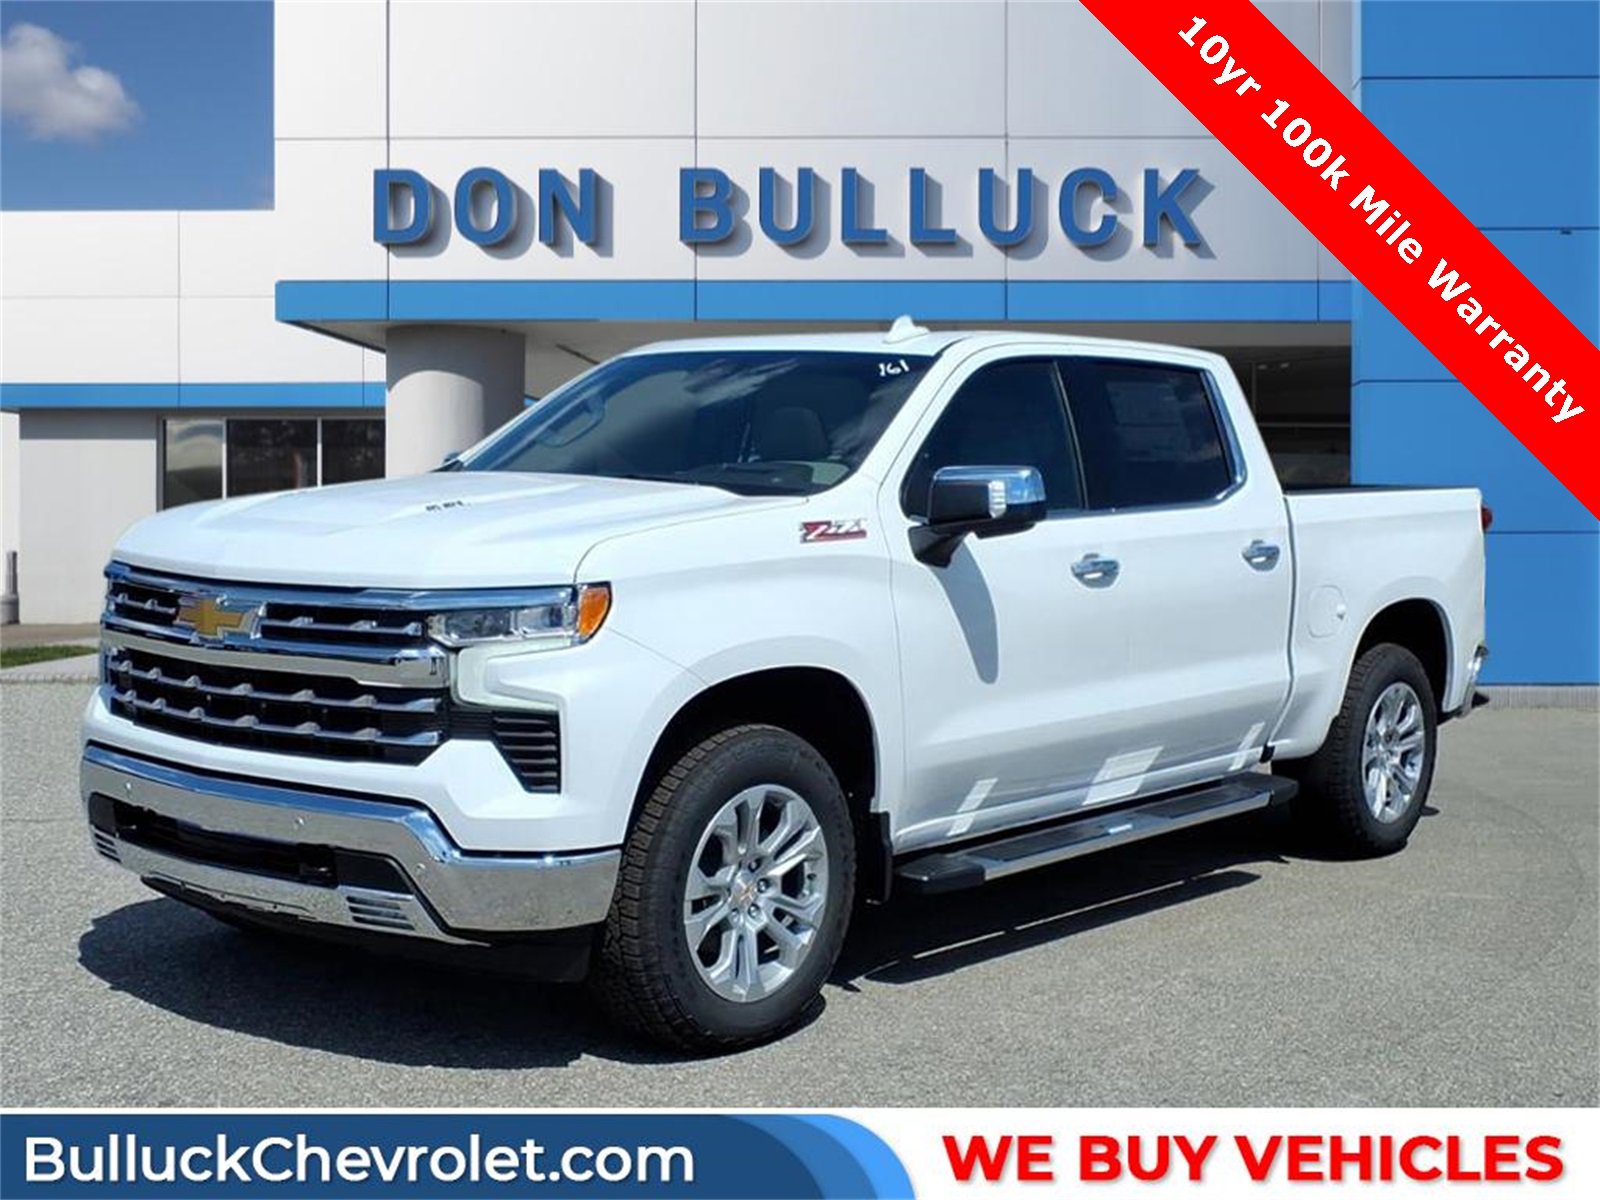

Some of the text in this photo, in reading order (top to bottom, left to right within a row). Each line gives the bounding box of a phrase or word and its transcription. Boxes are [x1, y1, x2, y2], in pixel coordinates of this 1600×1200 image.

[373, 166, 1202, 247] DON BULLUCK
[878, 358, 910, 377] 161
